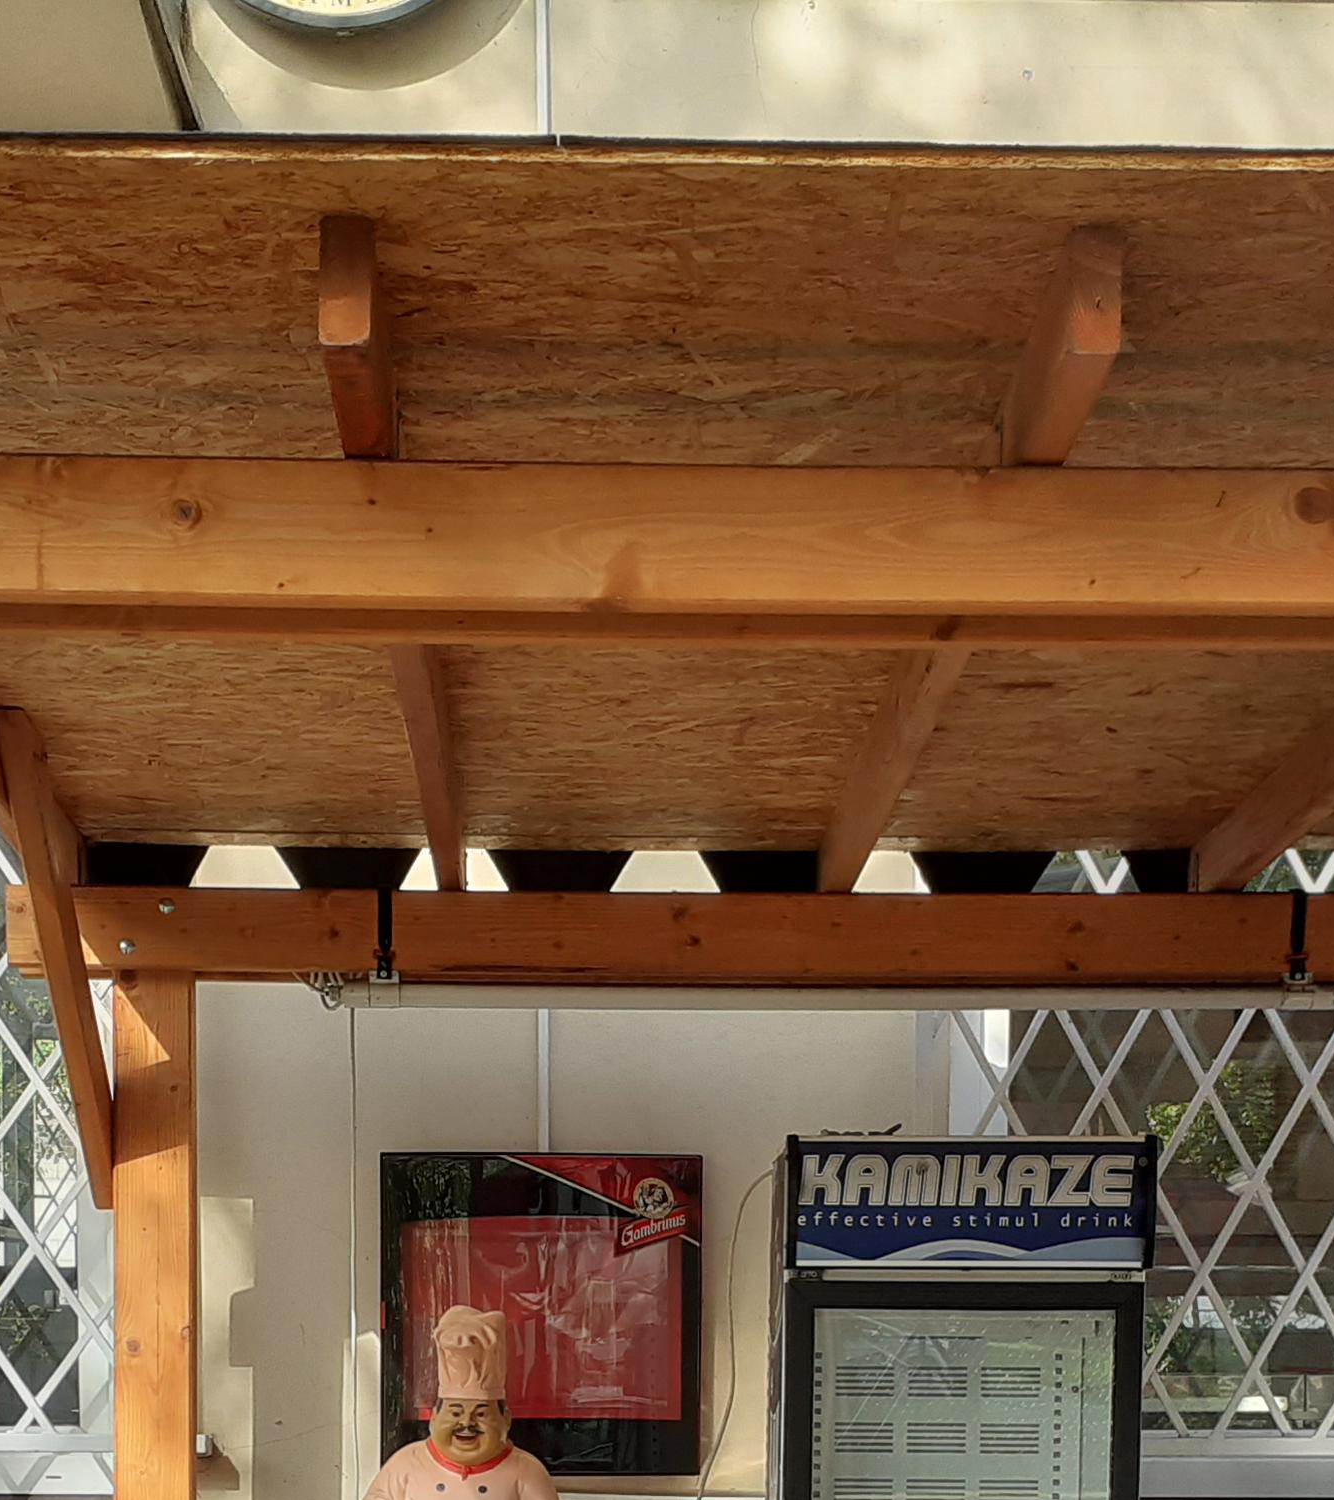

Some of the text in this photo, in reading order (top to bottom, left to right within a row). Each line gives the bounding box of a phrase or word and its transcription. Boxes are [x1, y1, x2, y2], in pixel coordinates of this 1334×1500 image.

[797, 1154, 1136, 1207] KAMIKAZE
[621, 1214, 687, 1247] Gambrinus
[797, 1211, 1134, 1228] effective stimul drink
